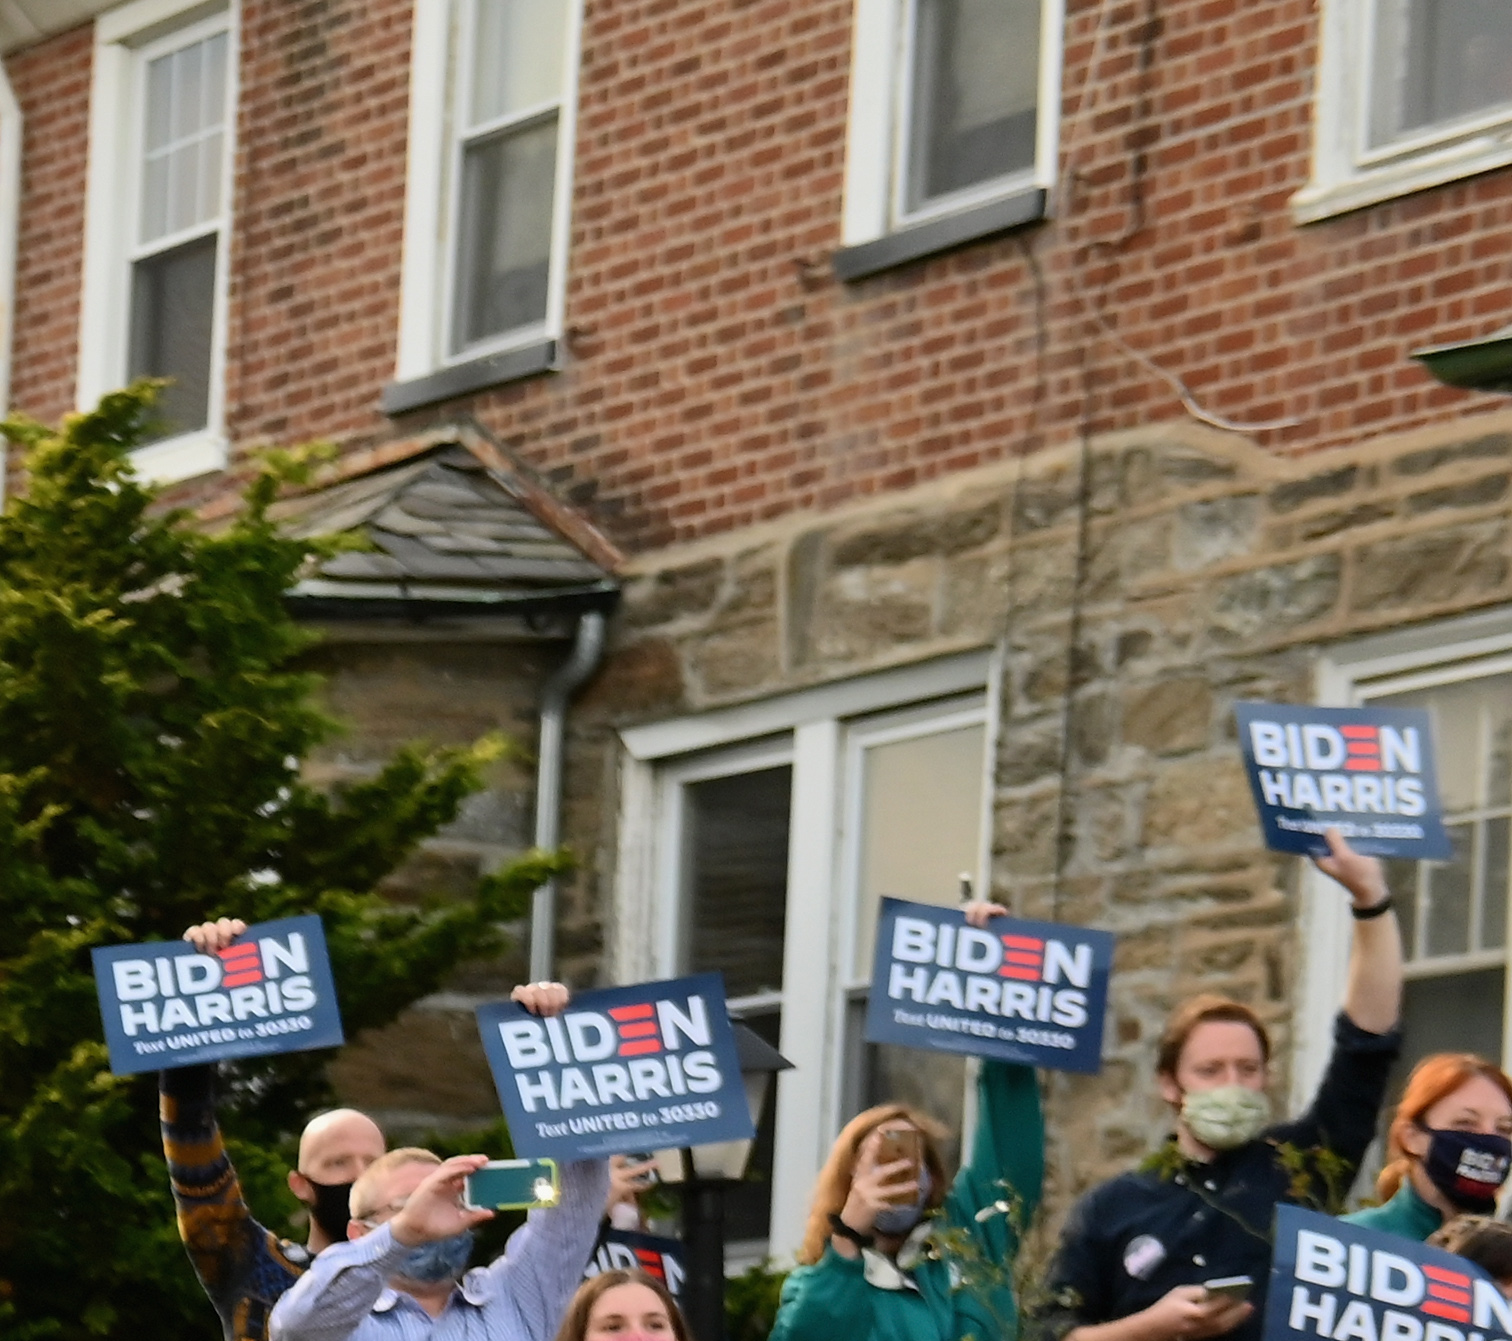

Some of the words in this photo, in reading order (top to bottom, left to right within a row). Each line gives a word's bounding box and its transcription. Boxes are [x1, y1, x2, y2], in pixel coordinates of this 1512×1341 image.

[1249, 720, 1421, 773] BIDEN
[1258, 770, 1427, 817] HARRIS
[112, 932, 310, 1002] BIDEN
[892, 916, 1092, 988] BIDEN
[119, 975, 316, 1037] HARRIS
[888, 963, 1089, 1028] HARRIS
[166, 1028, 236, 1050] UNITED
[498, 995, 712, 1069] BIDEN
[515, 1050, 723, 1113] HARRIS
[568, 1111, 639, 1135] UNITED
[1293, 1228, 1512, 1337] BIDEN
